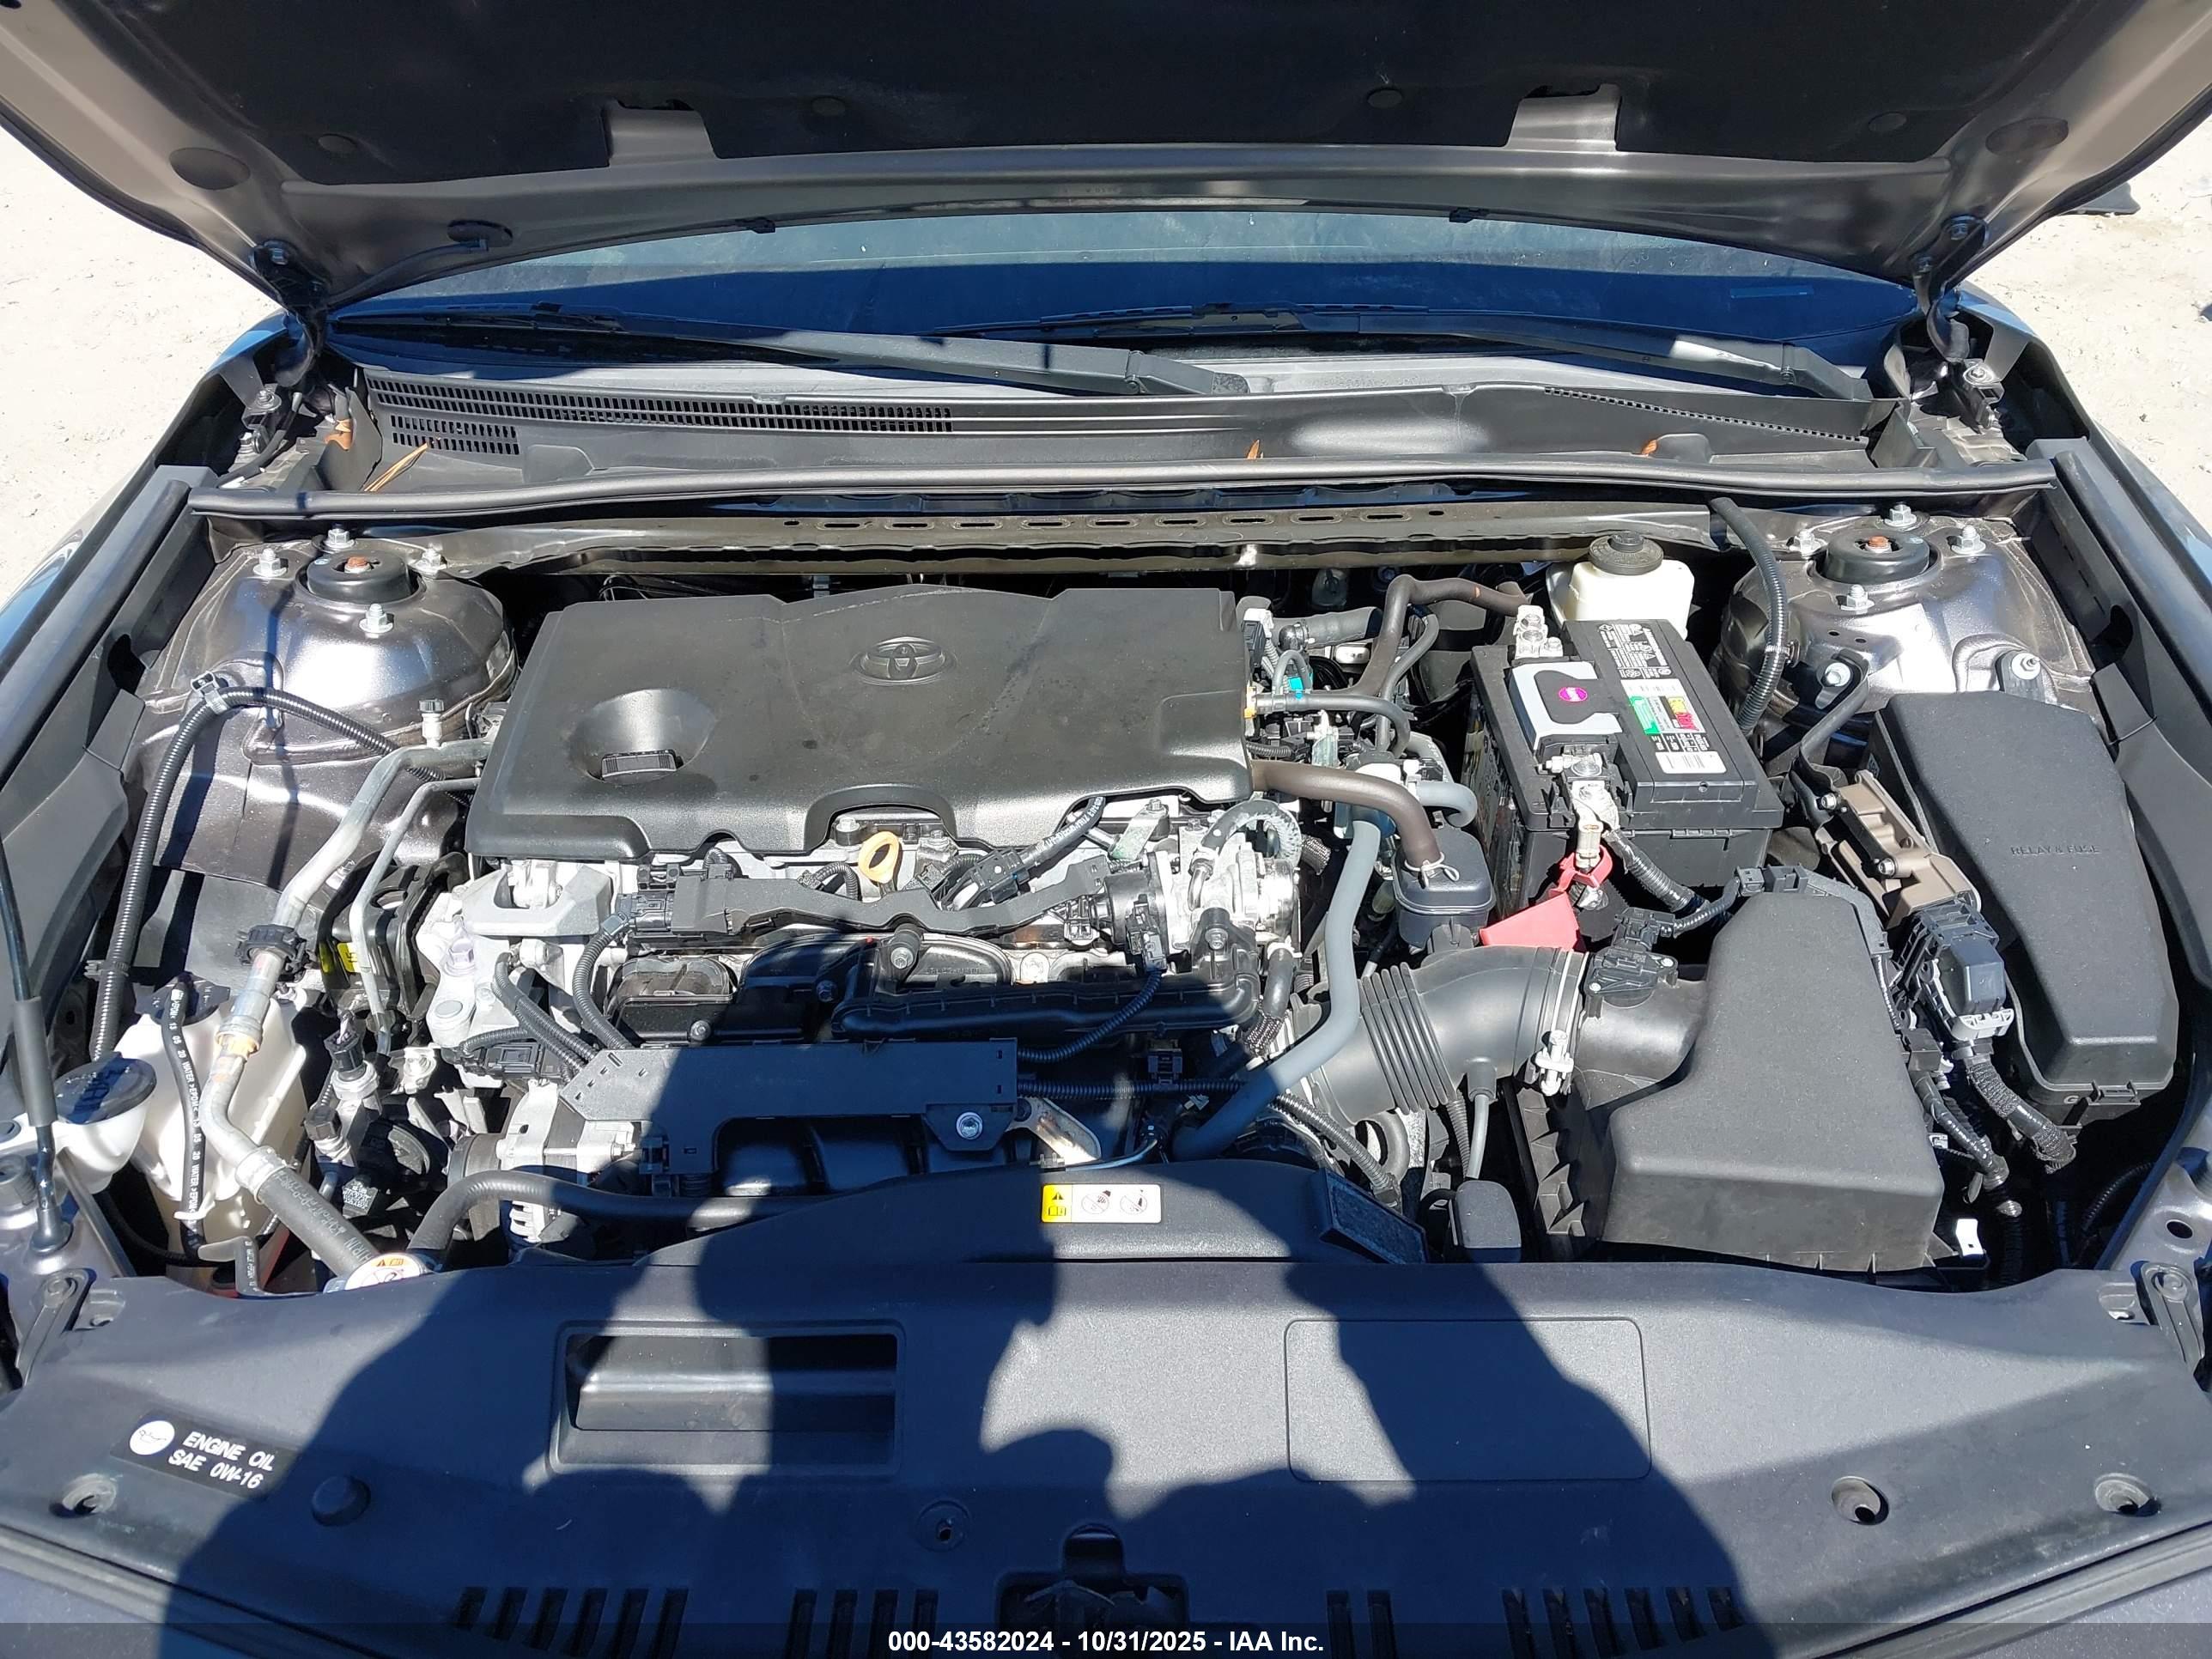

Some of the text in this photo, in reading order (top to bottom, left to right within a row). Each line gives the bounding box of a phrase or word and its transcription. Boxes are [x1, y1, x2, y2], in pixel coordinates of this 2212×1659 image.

[2010, 845, 2051, 855] RELAY
[2067, 844, 2100, 854] FUSE
[182, 1061, 195, 1082] WATER
[189, 1164, 200, 1187] WATER
[168, 1449, 264, 1489] SAE 0W-16
[182, 1431, 276, 1472] ENGINE OIL
